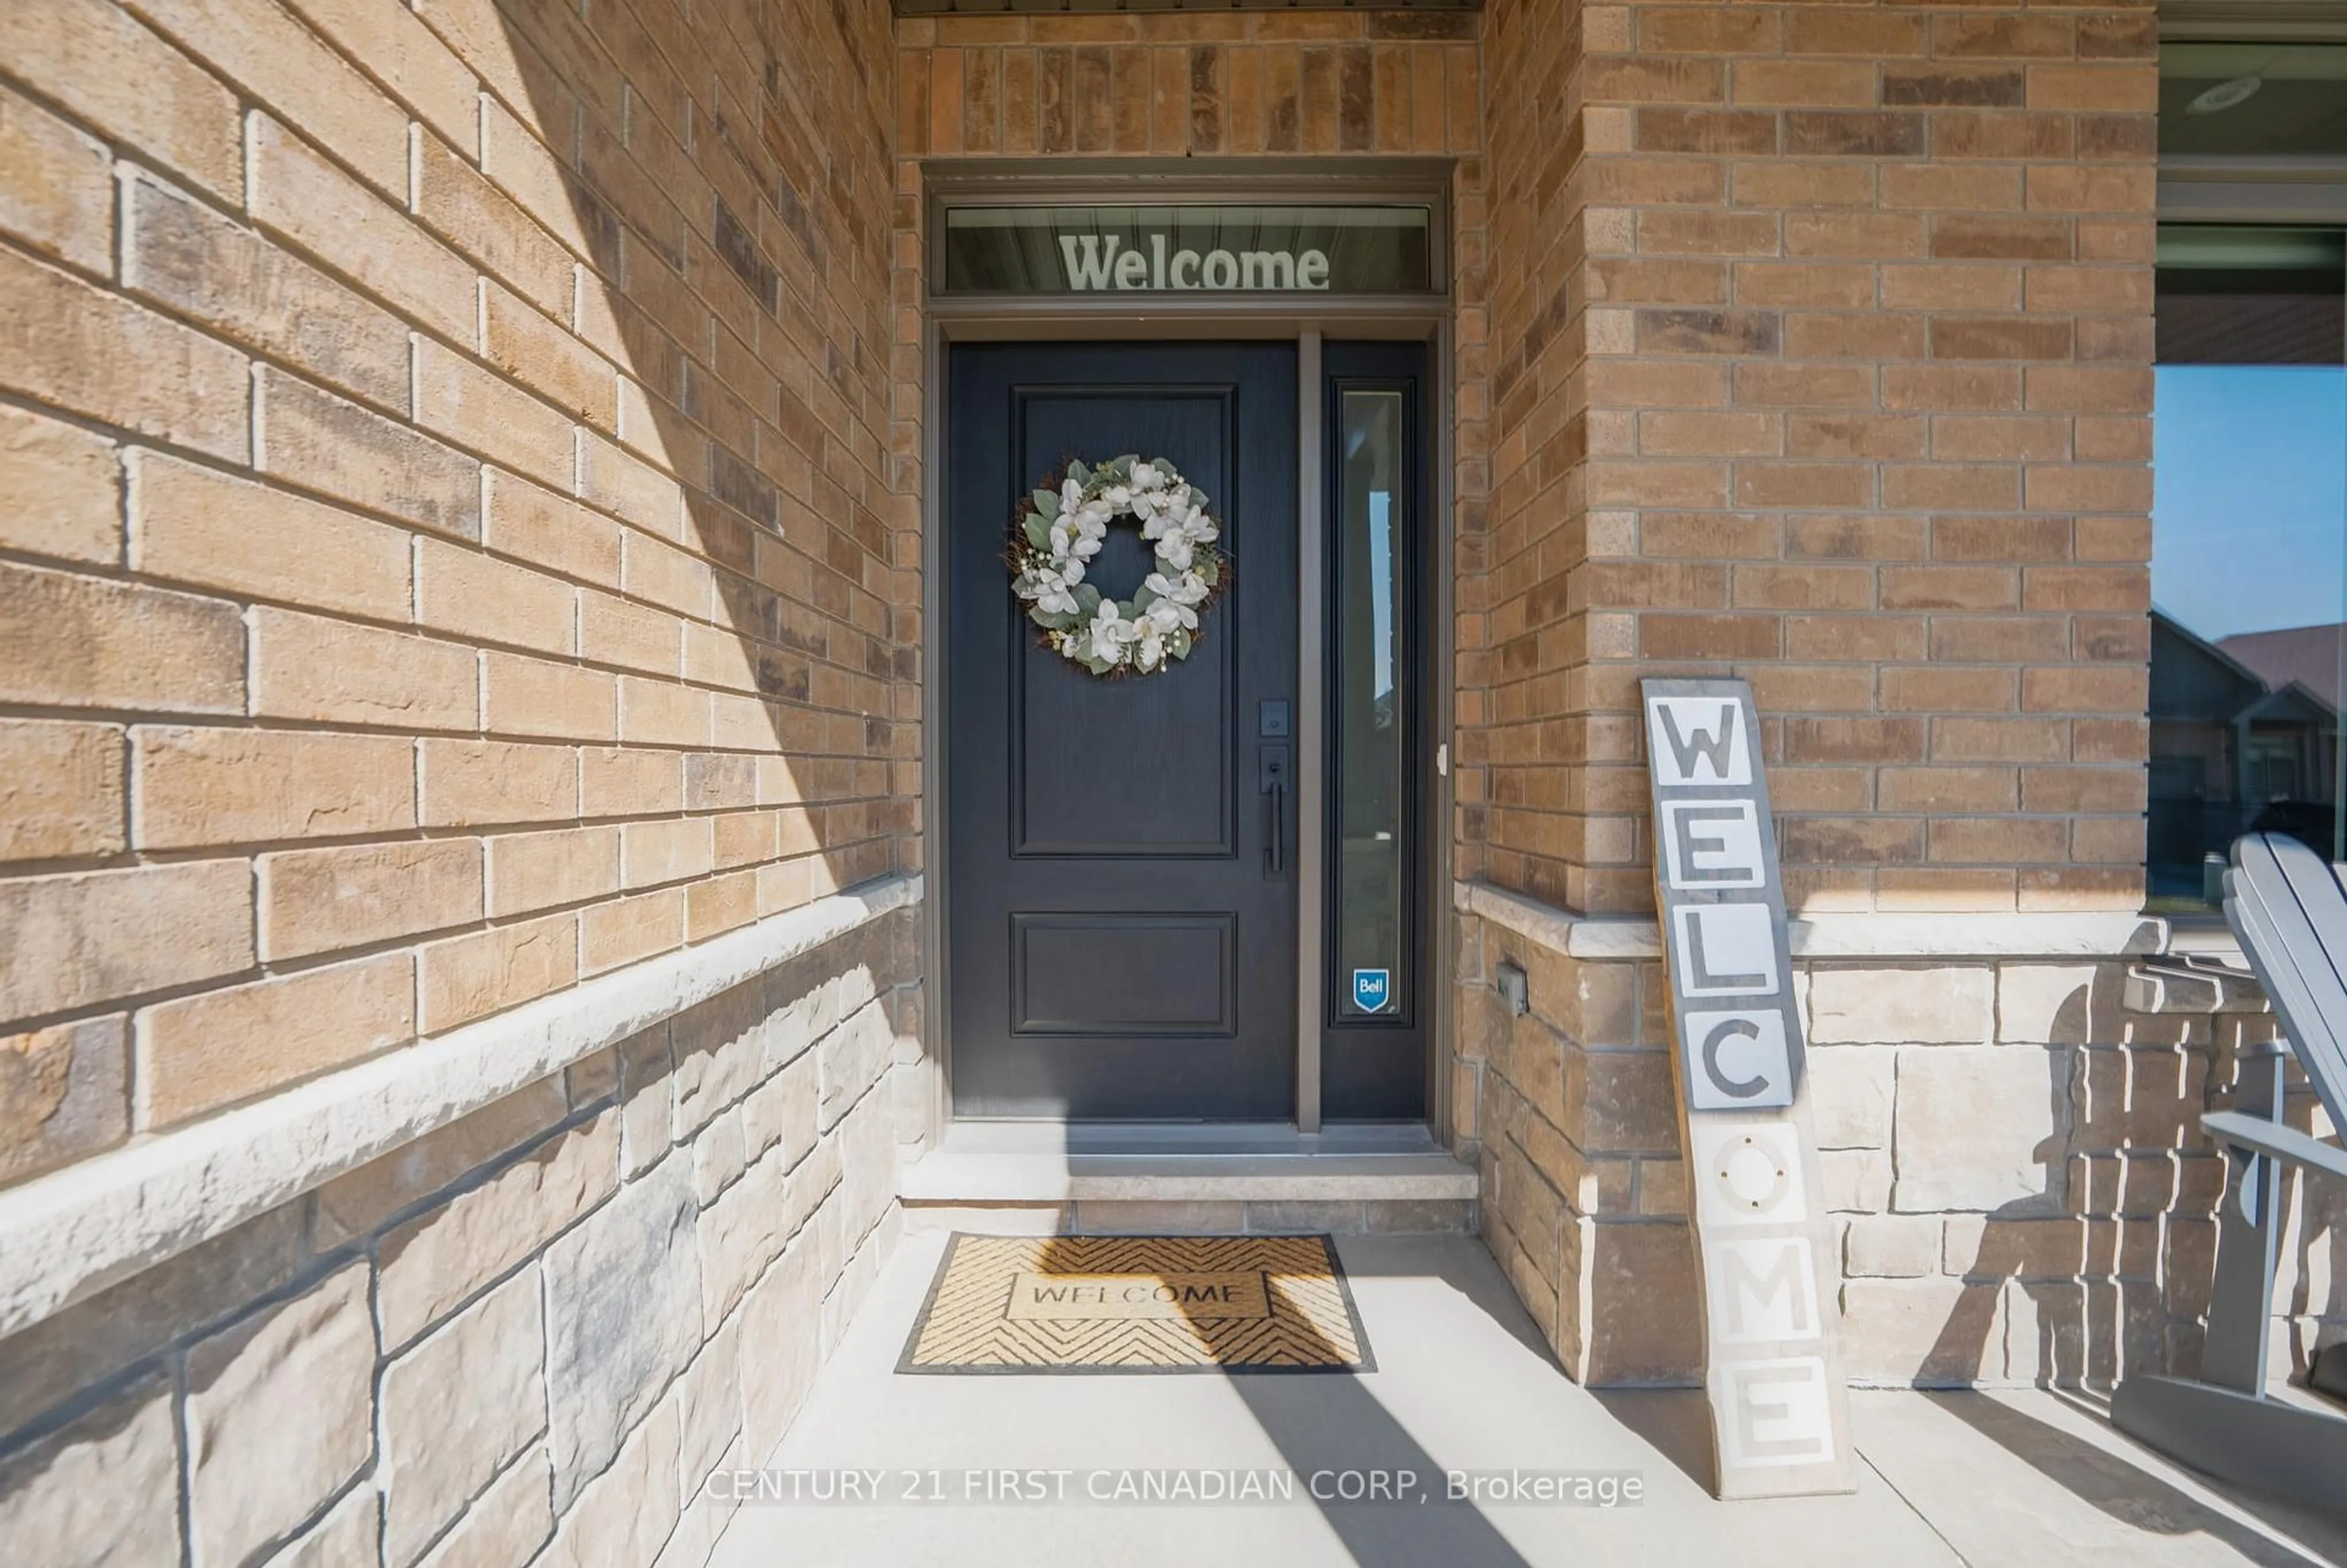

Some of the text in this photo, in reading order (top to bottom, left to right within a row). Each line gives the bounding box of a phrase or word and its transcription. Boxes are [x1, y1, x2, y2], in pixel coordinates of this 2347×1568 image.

[1059, 235, 1330, 290] Welcome
[1359, 978, 1383, 994] Bell
[1655, 703, 1824, 1458] WELCOME
[1034, 1284, 1244, 1303] WELCOME
